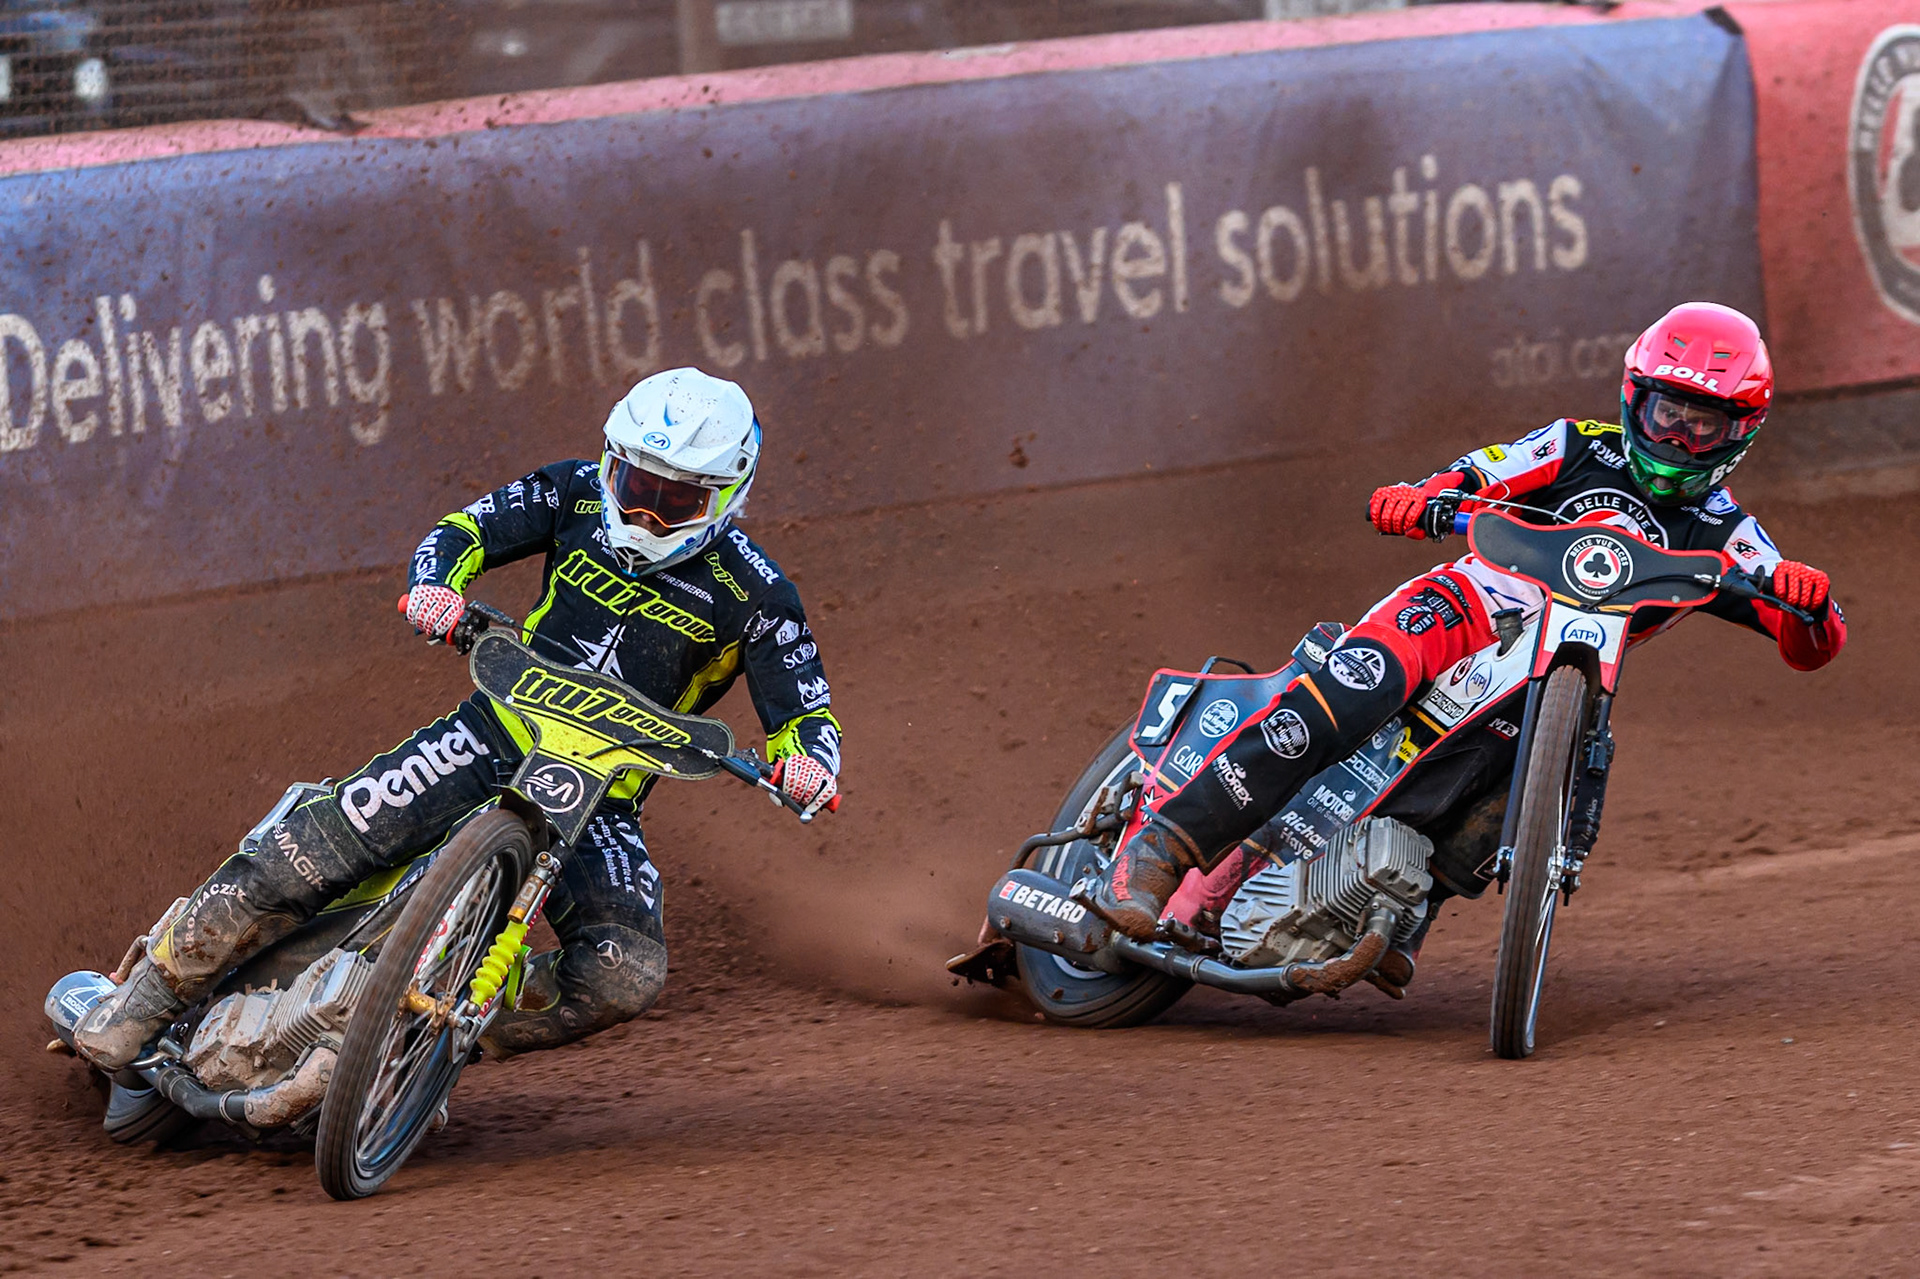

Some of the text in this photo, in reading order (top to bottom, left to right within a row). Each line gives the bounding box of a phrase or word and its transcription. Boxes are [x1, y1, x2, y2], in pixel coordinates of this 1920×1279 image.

[0, 155, 1588, 452] Delivering world class travel solutions
[1653, 364, 1719, 392] BOLL
[1588, 439, 1627, 468] ROWE
[1573, 496, 1621, 513] BELLE
[1627, 503, 1652, 529] VUE
[728, 528, 780, 585] Pentel
[1569, 538, 1629, 567] BELLE VUE ACES
[1567, 628, 1598, 643] ATPI
[1469, 672, 1488, 690] ATPI
[605, 703, 692, 749] group
[1141, 683, 1194, 738] 5
[340, 719, 490, 833] Pentel
[1173, 745, 1204, 776] GAR
[1217, 753, 1253, 806] MOTOREX
[1281, 810, 1328, 849] Richar
[1012, 885, 1087, 924] BETARD
